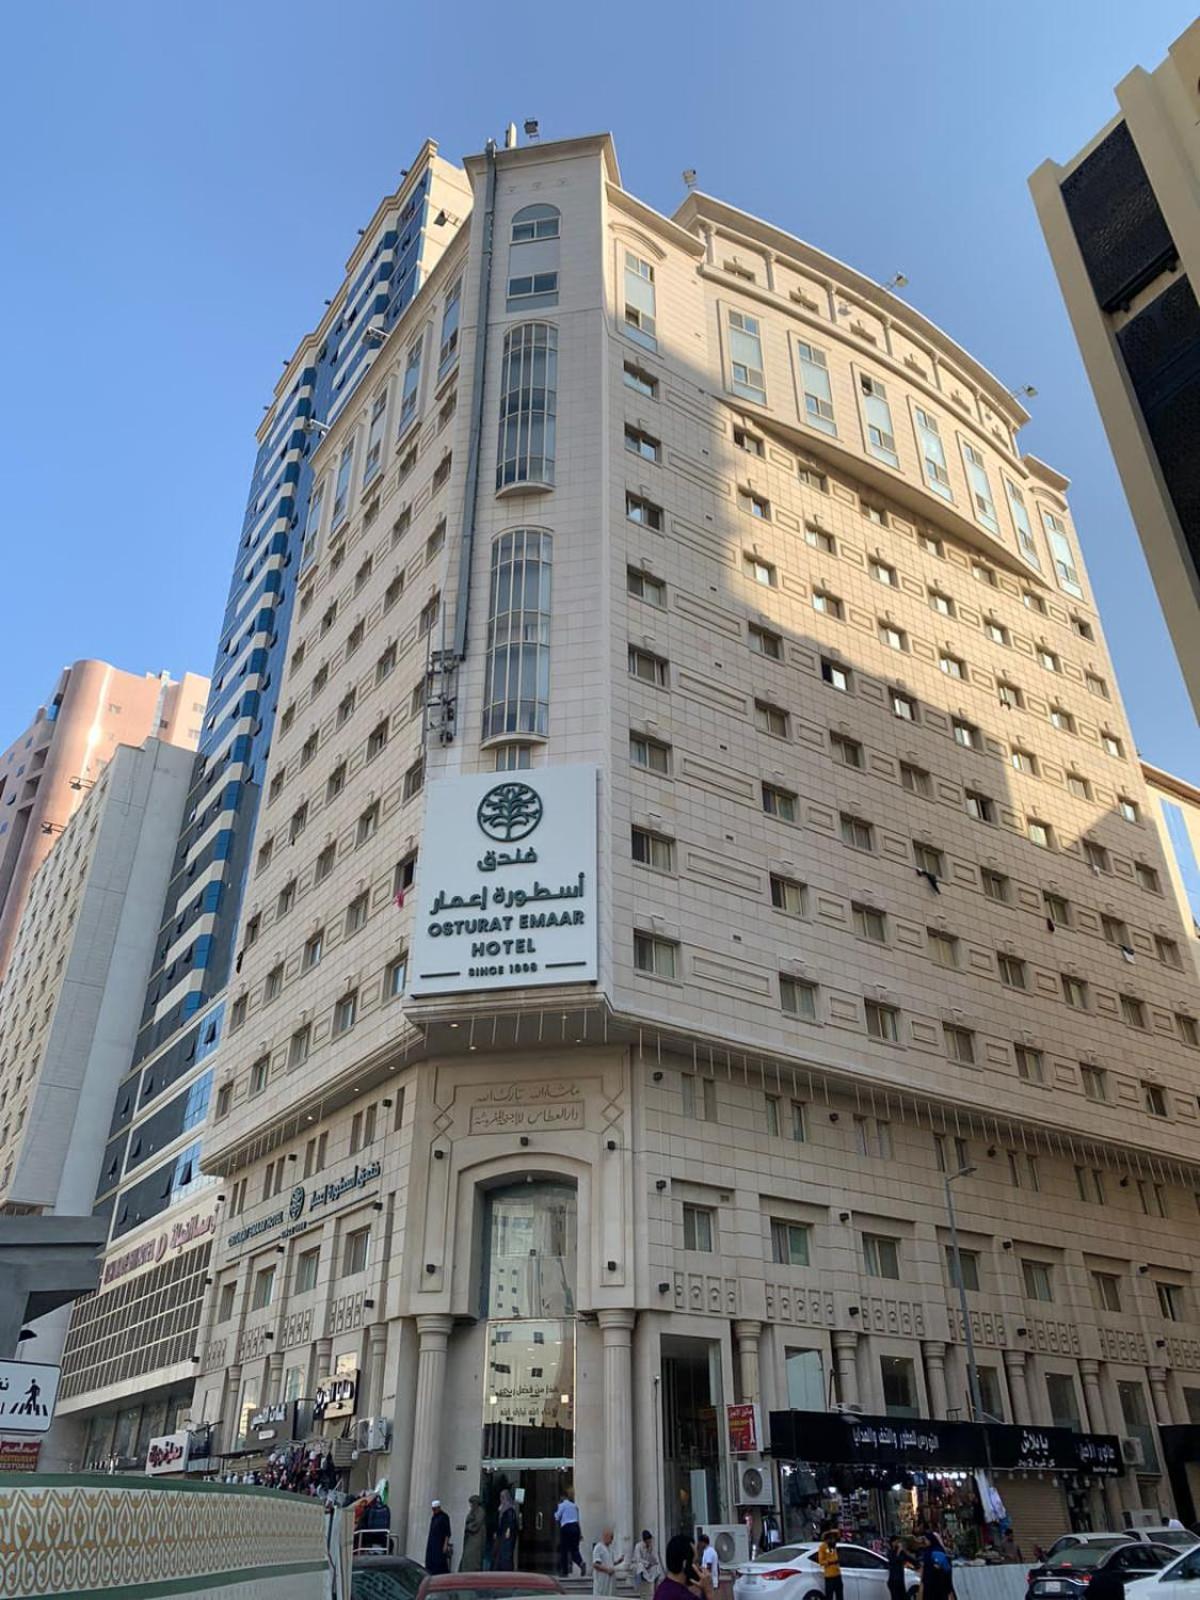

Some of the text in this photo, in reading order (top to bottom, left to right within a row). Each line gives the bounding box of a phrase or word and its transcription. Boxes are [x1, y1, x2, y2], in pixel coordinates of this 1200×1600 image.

[477, 846, 538, 872] فندق
[429, 872, 585, 915] أسطورة إعمار
[428, 910, 585, 938] OSTURAT EMAAR
[471, 938, 537, 958] HOTEL
[468, 965, 504, 978] SINCE
